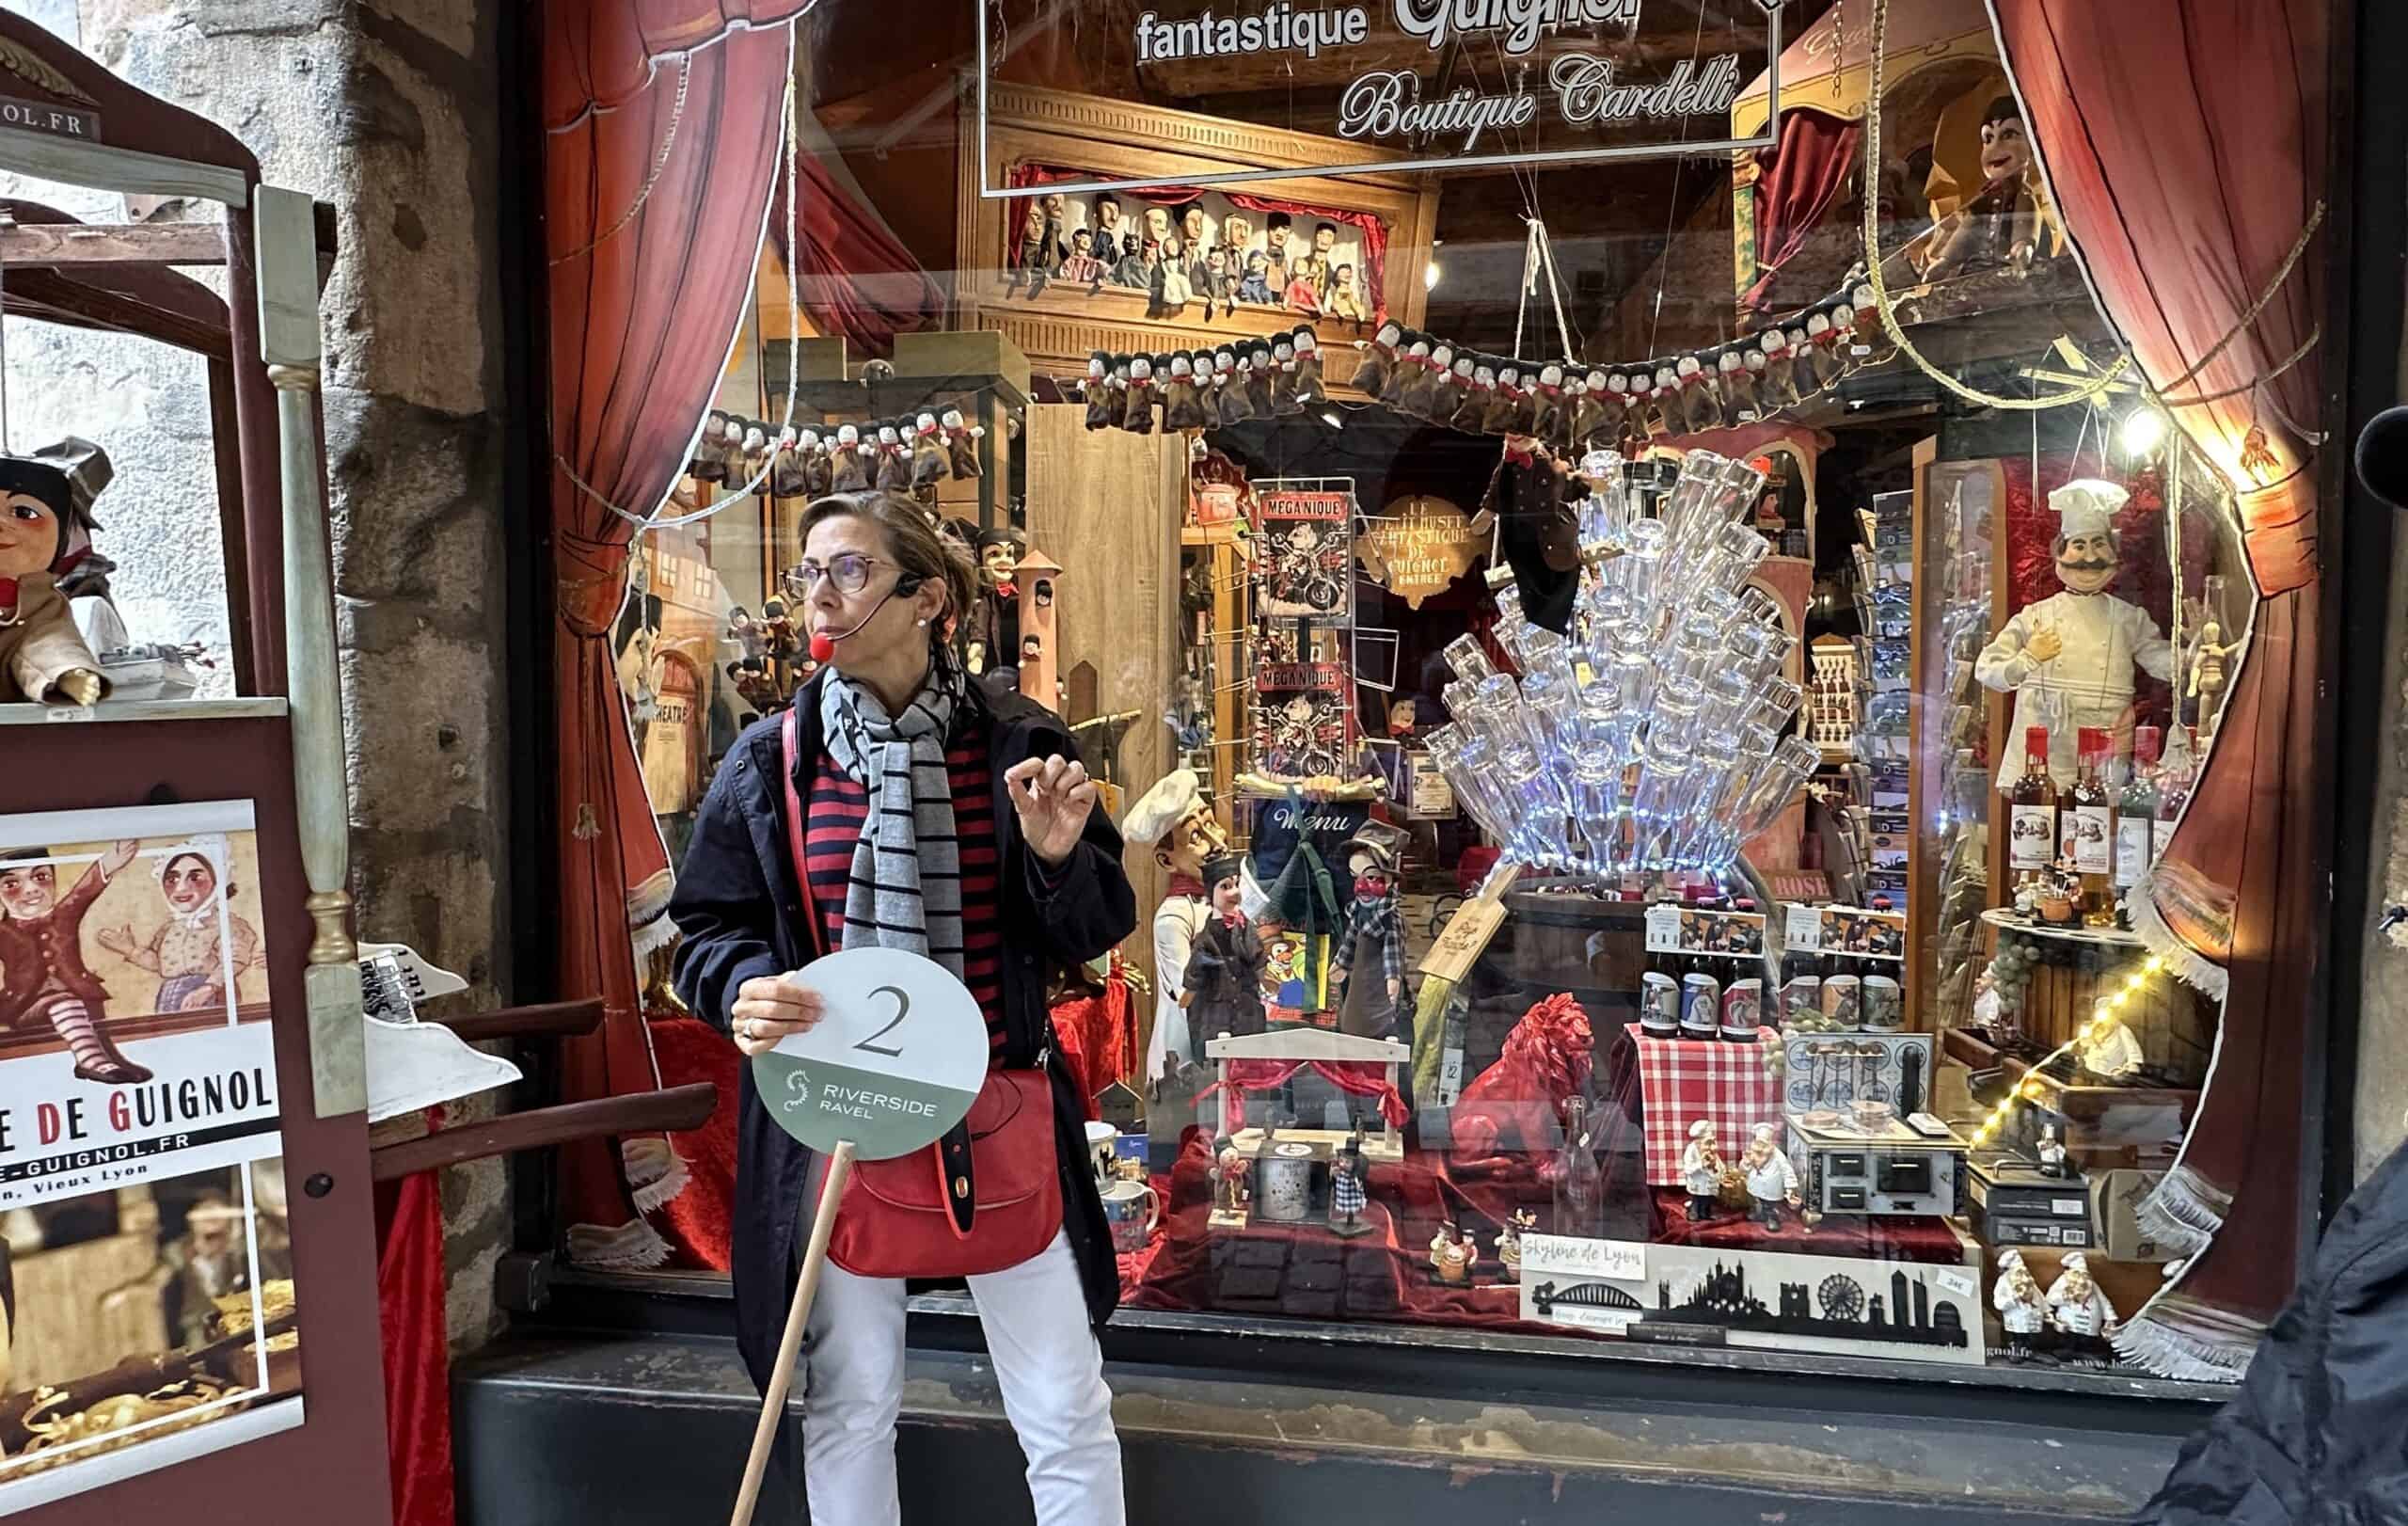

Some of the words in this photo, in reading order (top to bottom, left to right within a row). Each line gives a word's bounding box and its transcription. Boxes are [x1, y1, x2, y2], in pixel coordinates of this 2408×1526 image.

[1136, 3, 1369, 58] fantastique
[1393, 0, 1640, 55] Guigno
[1338, 71, 1536, 151] Boutique
[1549, 53, 1740, 123] Cardelli
[2, 103, 83, 135] OL.FR
[1273, 807, 1352, 831] Menu
[851, 984, 911, 1057] 2
[38, 1097, 87, 1145] DE
[109, 1068, 273, 1132] GUIGNOL
[819, 1100, 874, 1120] RAVEL
[823, 1083, 939, 1118] RIVERSIDE
[34, 1175, 91, 1194] Vieux
[103, 1163, 149, 1182] Lyon
[1603, 1245, 1641, 1271] Lyon
